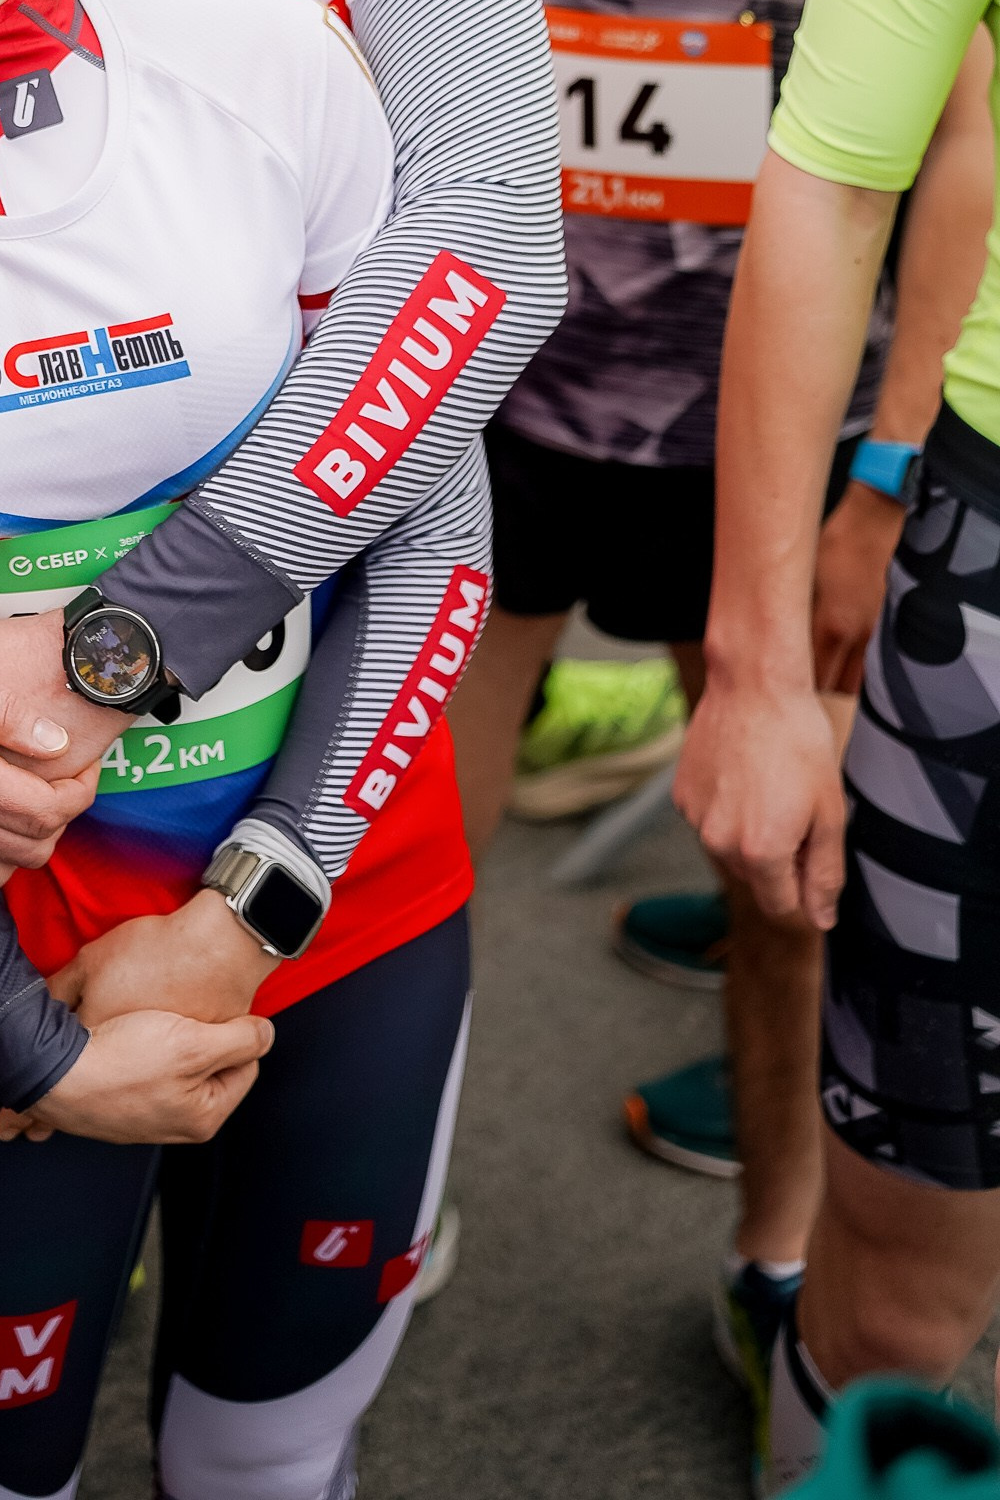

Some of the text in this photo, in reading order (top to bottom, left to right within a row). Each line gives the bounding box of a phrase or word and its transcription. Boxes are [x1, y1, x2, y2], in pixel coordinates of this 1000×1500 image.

[566, 75, 672, 156] 14
[19, 377, 123, 406] МЕГИОННЕФТЕГАЗ
[313, 269, 489, 500] BIVIUM
[36, 549, 89, 570] СБЕР
[357, 579, 485, 810] BIVIUM
[101, 734, 175, 784] 4,2
